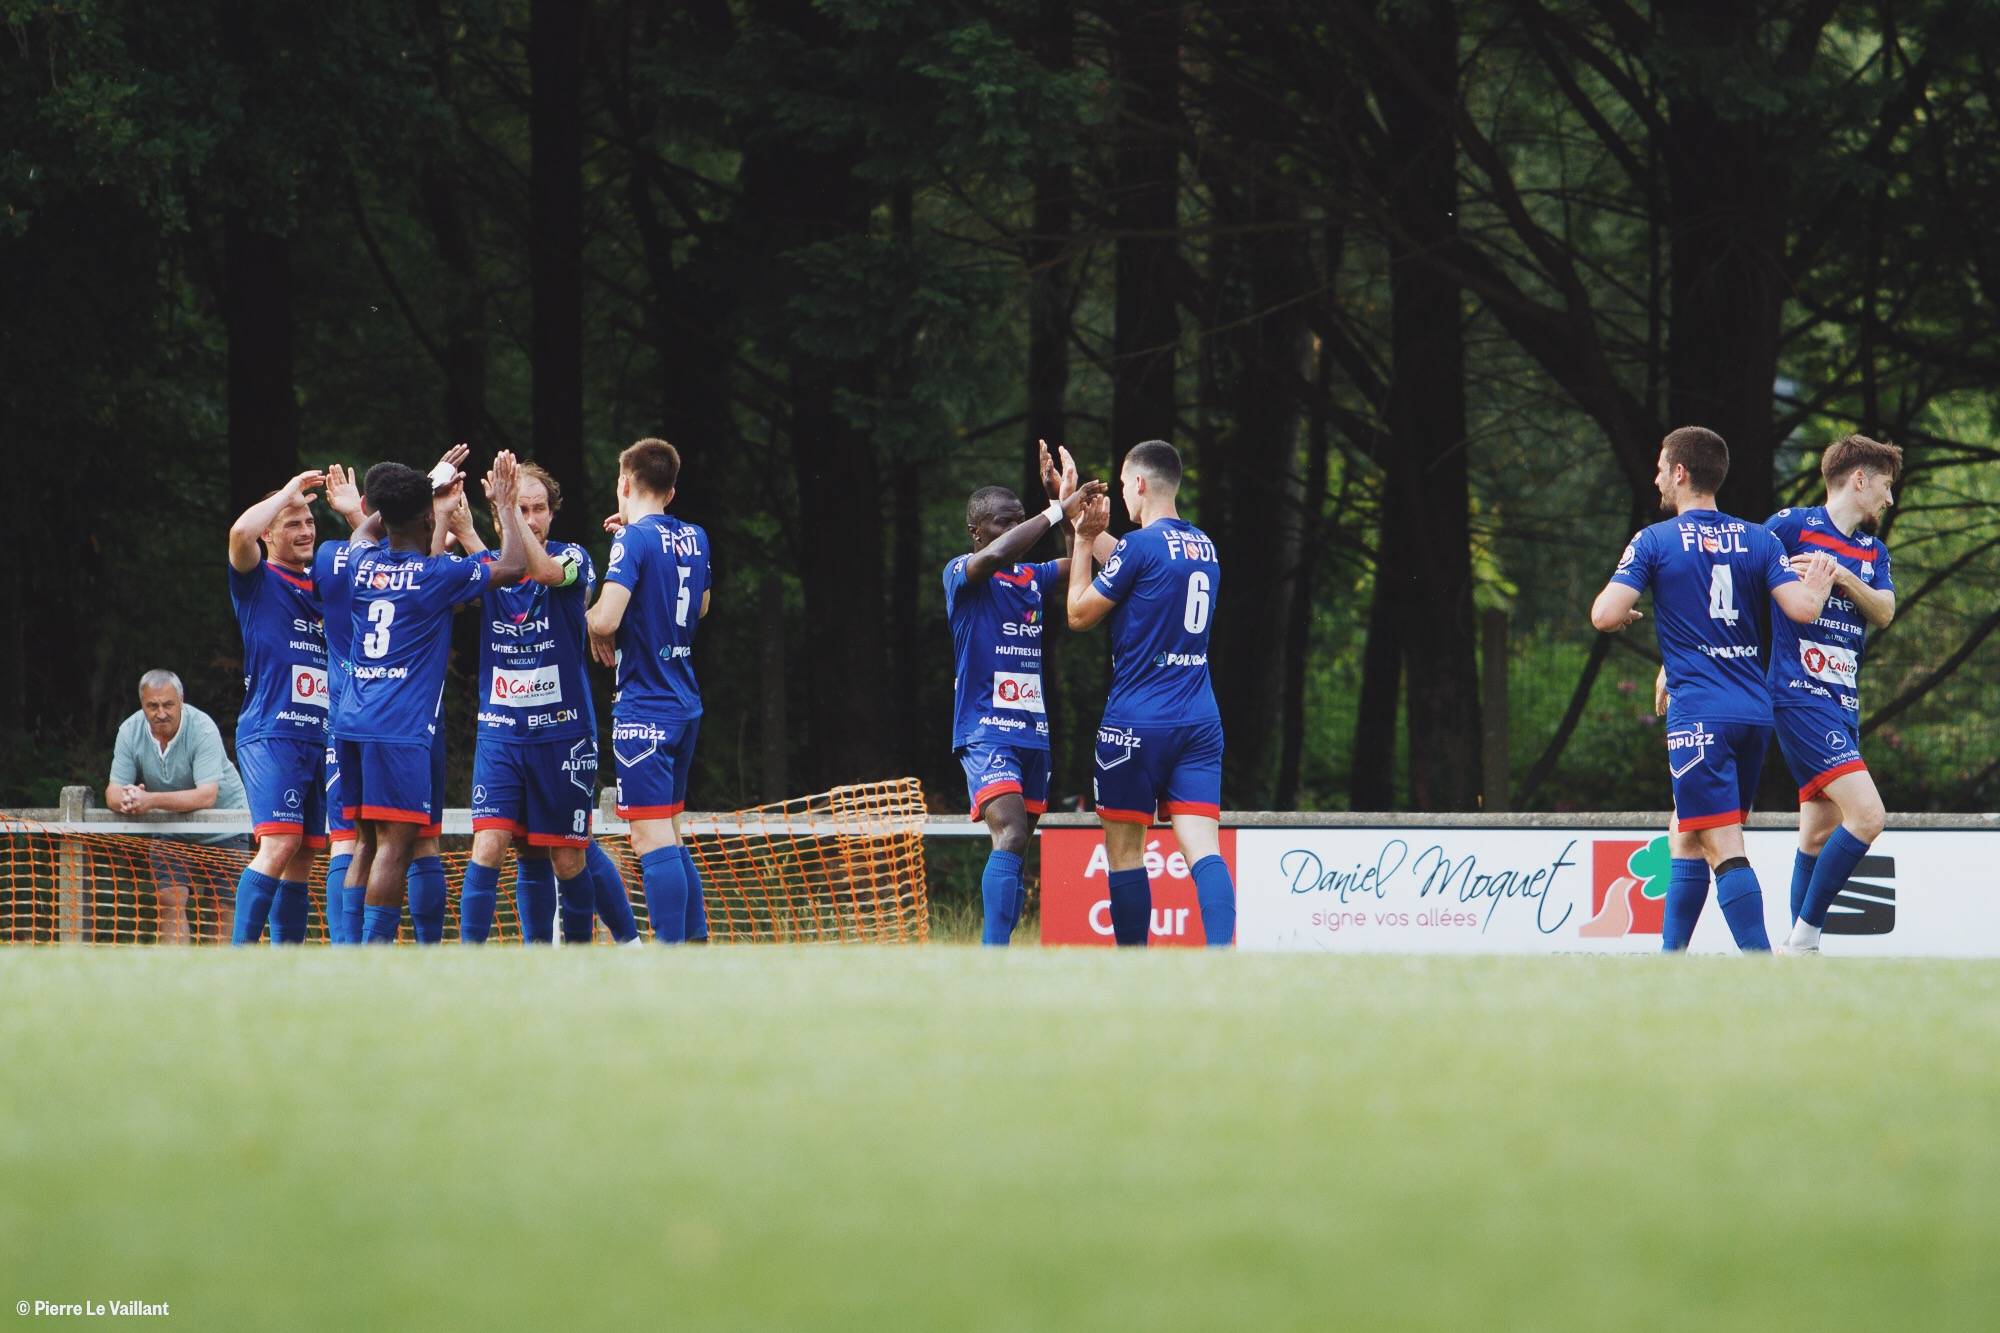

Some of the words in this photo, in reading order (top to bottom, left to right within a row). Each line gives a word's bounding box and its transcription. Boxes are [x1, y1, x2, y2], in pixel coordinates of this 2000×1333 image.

[1163, 530, 1180, 540] LE
[1678, 522, 1697, 532] LE
[1698, 522, 1746, 538] BELLER
[1681, 532, 1748, 554] FIOUL
[358, 560, 375, 570] LE
[375, 561, 424, 572] BELLER
[354, 570, 421, 591] FIOUL
[676, 565, 691, 627] 5
[1183, 571, 1210, 634] 6
[1709, 564, 1739, 626] 4
[293, 618, 324, 637] SR
[363, 599, 396, 659] 3
[492, 616, 550, 637] SRPN
[520, 645, 532, 653] LE
[509, 679, 556, 695] Caliéco
[612, 728, 666, 740] UTOPUZZ
[1097, 730, 1142, 748] TOPUZZ
[1667, 734, 1715, 751] TOPUZZ
[561, 760, 598, 771] AUTOP
[573, 809, 586, 833] 8
[1084, 840, 1191, 879] Aée
[1280, 839, 1408, 904] Daniel
[1412, 839, 1578, 935] Moquet
[1088, 899, 1190, 936] Cur
[1311, 910, 1367, 932] signe
[1375, 911, 1410, 927] vos
[1416, 907, 1478, 928] allées
